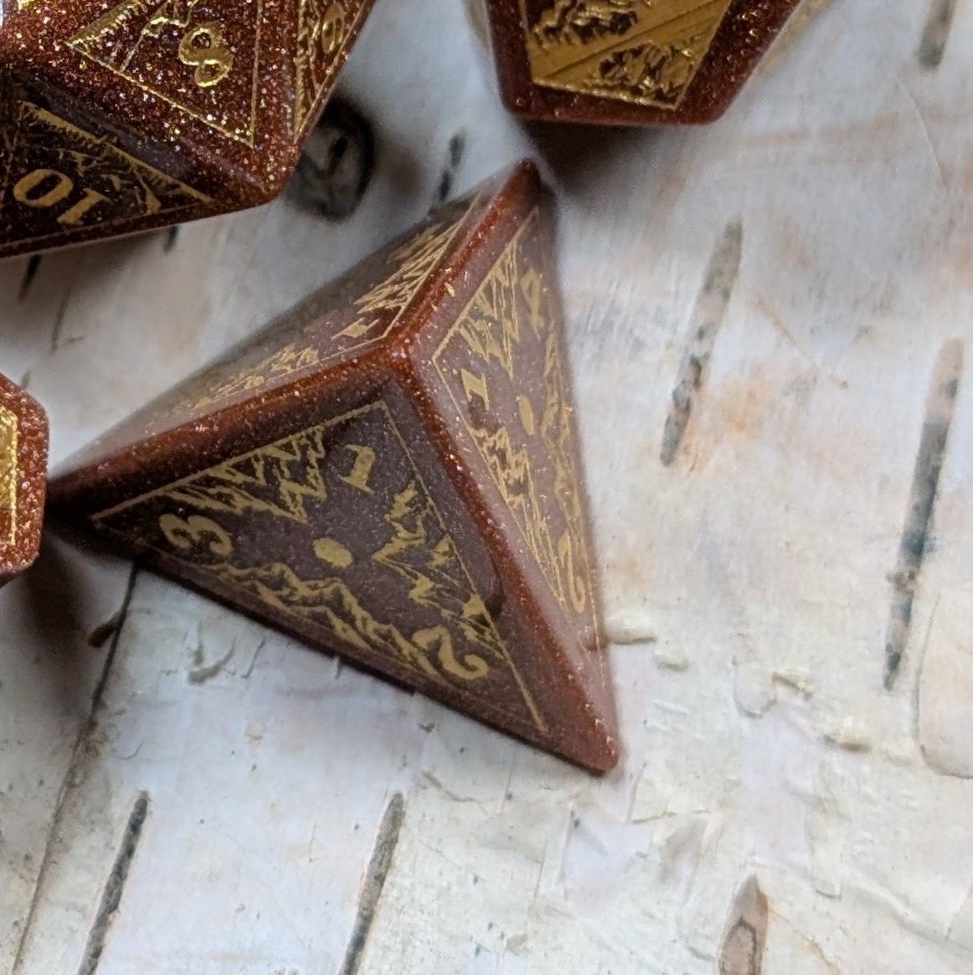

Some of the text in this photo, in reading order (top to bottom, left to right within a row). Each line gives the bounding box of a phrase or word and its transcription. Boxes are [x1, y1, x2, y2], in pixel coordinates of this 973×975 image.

[178, 26, 233, 88] 8
[13, 168, 113, 224] 10
[461, 367, 489, 411] 1
[340, 443, 377, 493] 1
[158, 513, 233, 555] 3
[557, 527, 587, 614] 2
[412, 625, 487, 681] 2
